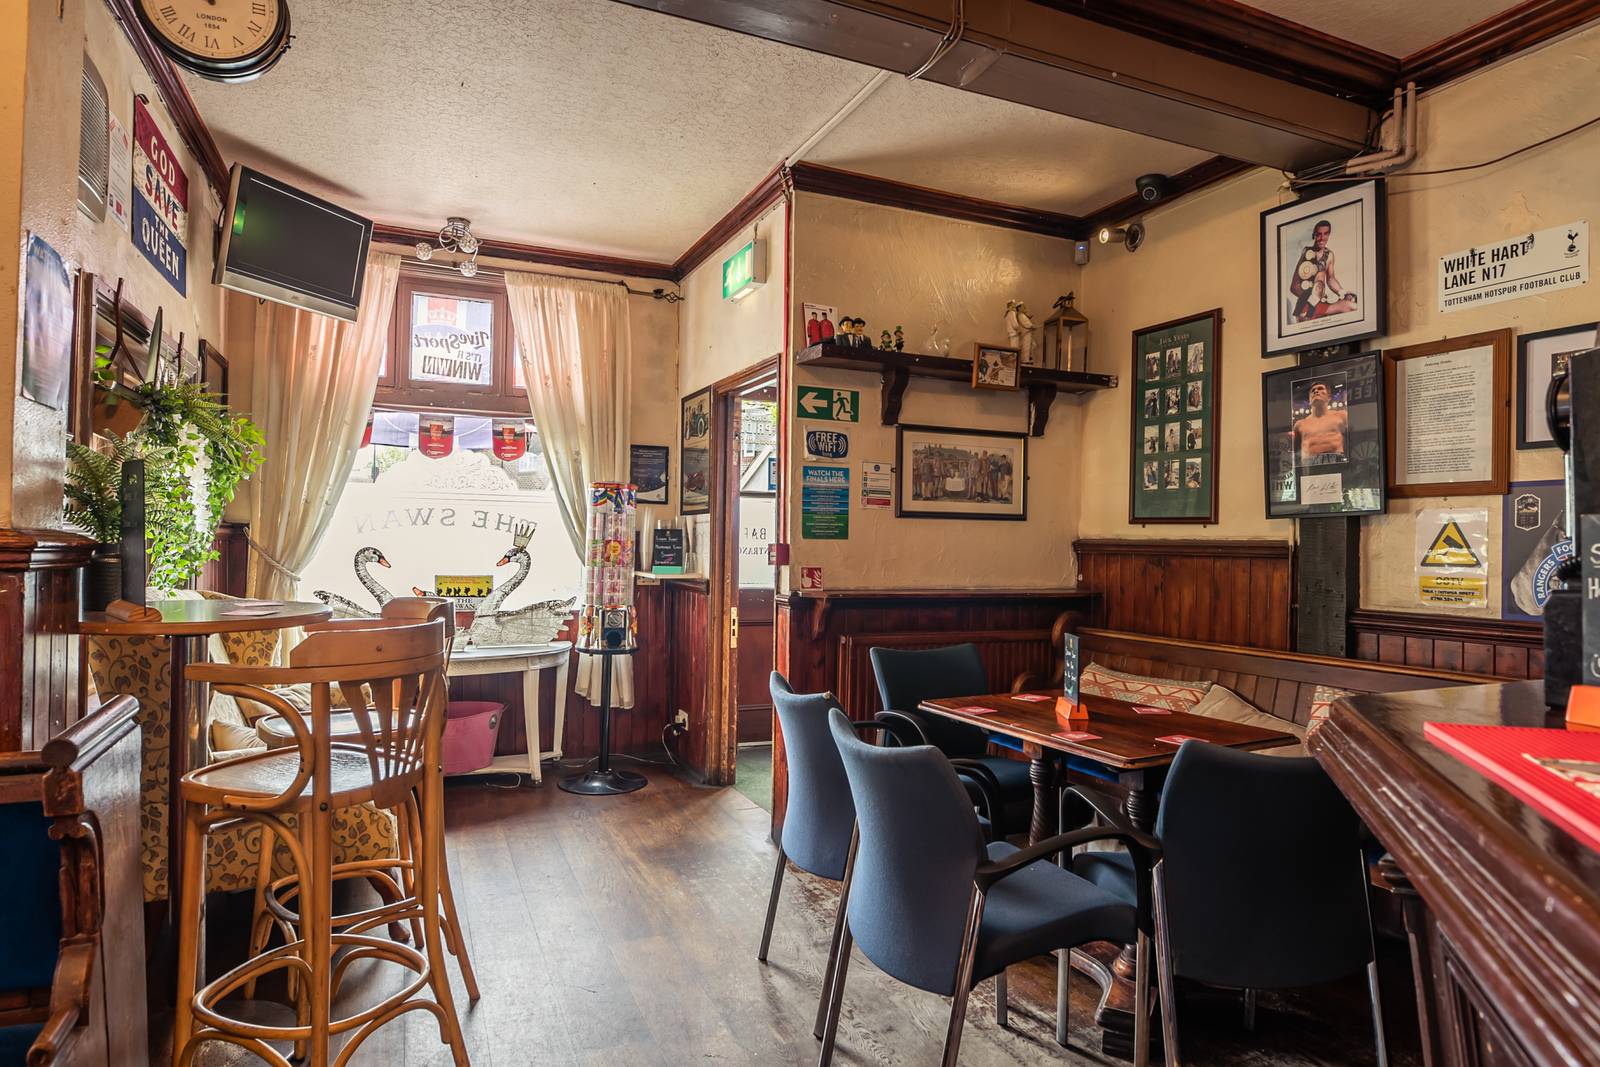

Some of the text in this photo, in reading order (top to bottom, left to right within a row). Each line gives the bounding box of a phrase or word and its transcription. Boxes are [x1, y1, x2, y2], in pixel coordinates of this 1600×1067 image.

[196, 12, 227, 23] LONDON
[151, 135, 175, 187] GOD
[145, 163, 178, 231] SAVE
[154, 214, 169, 241] THE
[141, 217, 179, 280] QUEEN
[1444, 240, 1528, 274] WHITE HART
[1444, 263, 1506, 290] LANE N17
[1444, 271, 1581, 307] TOTTENHAM HOTSPUR FOOTBALL CLUB
[816, 431, 838, 443] FREE
[807, 469, 831, 477] WATCH
[1435, 576, 1464, 586] CCTV
[1537, 559, 1556, 599] RANGERS
